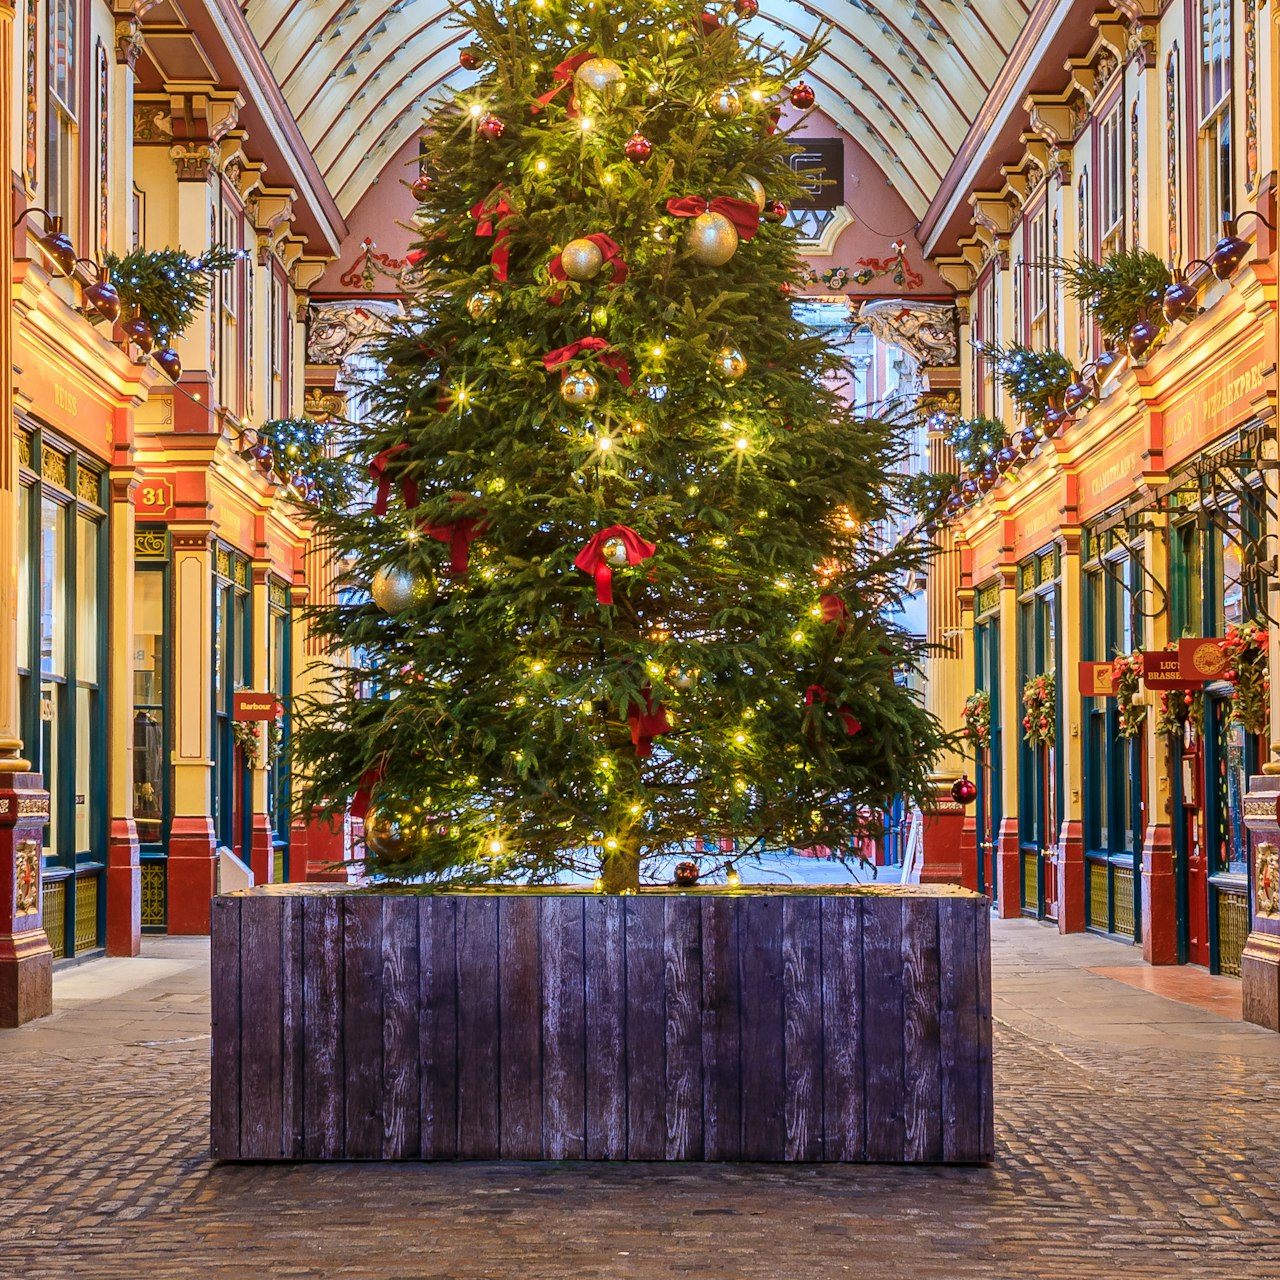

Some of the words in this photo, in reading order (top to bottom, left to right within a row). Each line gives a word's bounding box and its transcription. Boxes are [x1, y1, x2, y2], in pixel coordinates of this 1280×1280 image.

[54, 383, 77, 417] REISS
[1203, 359, 1267, 422] PIZZAEXPRES
[142, 487, 166, 506] 31
[1148, 671, 1184, 680] BRASSE
[240, 702, 271, 711] Barbour
